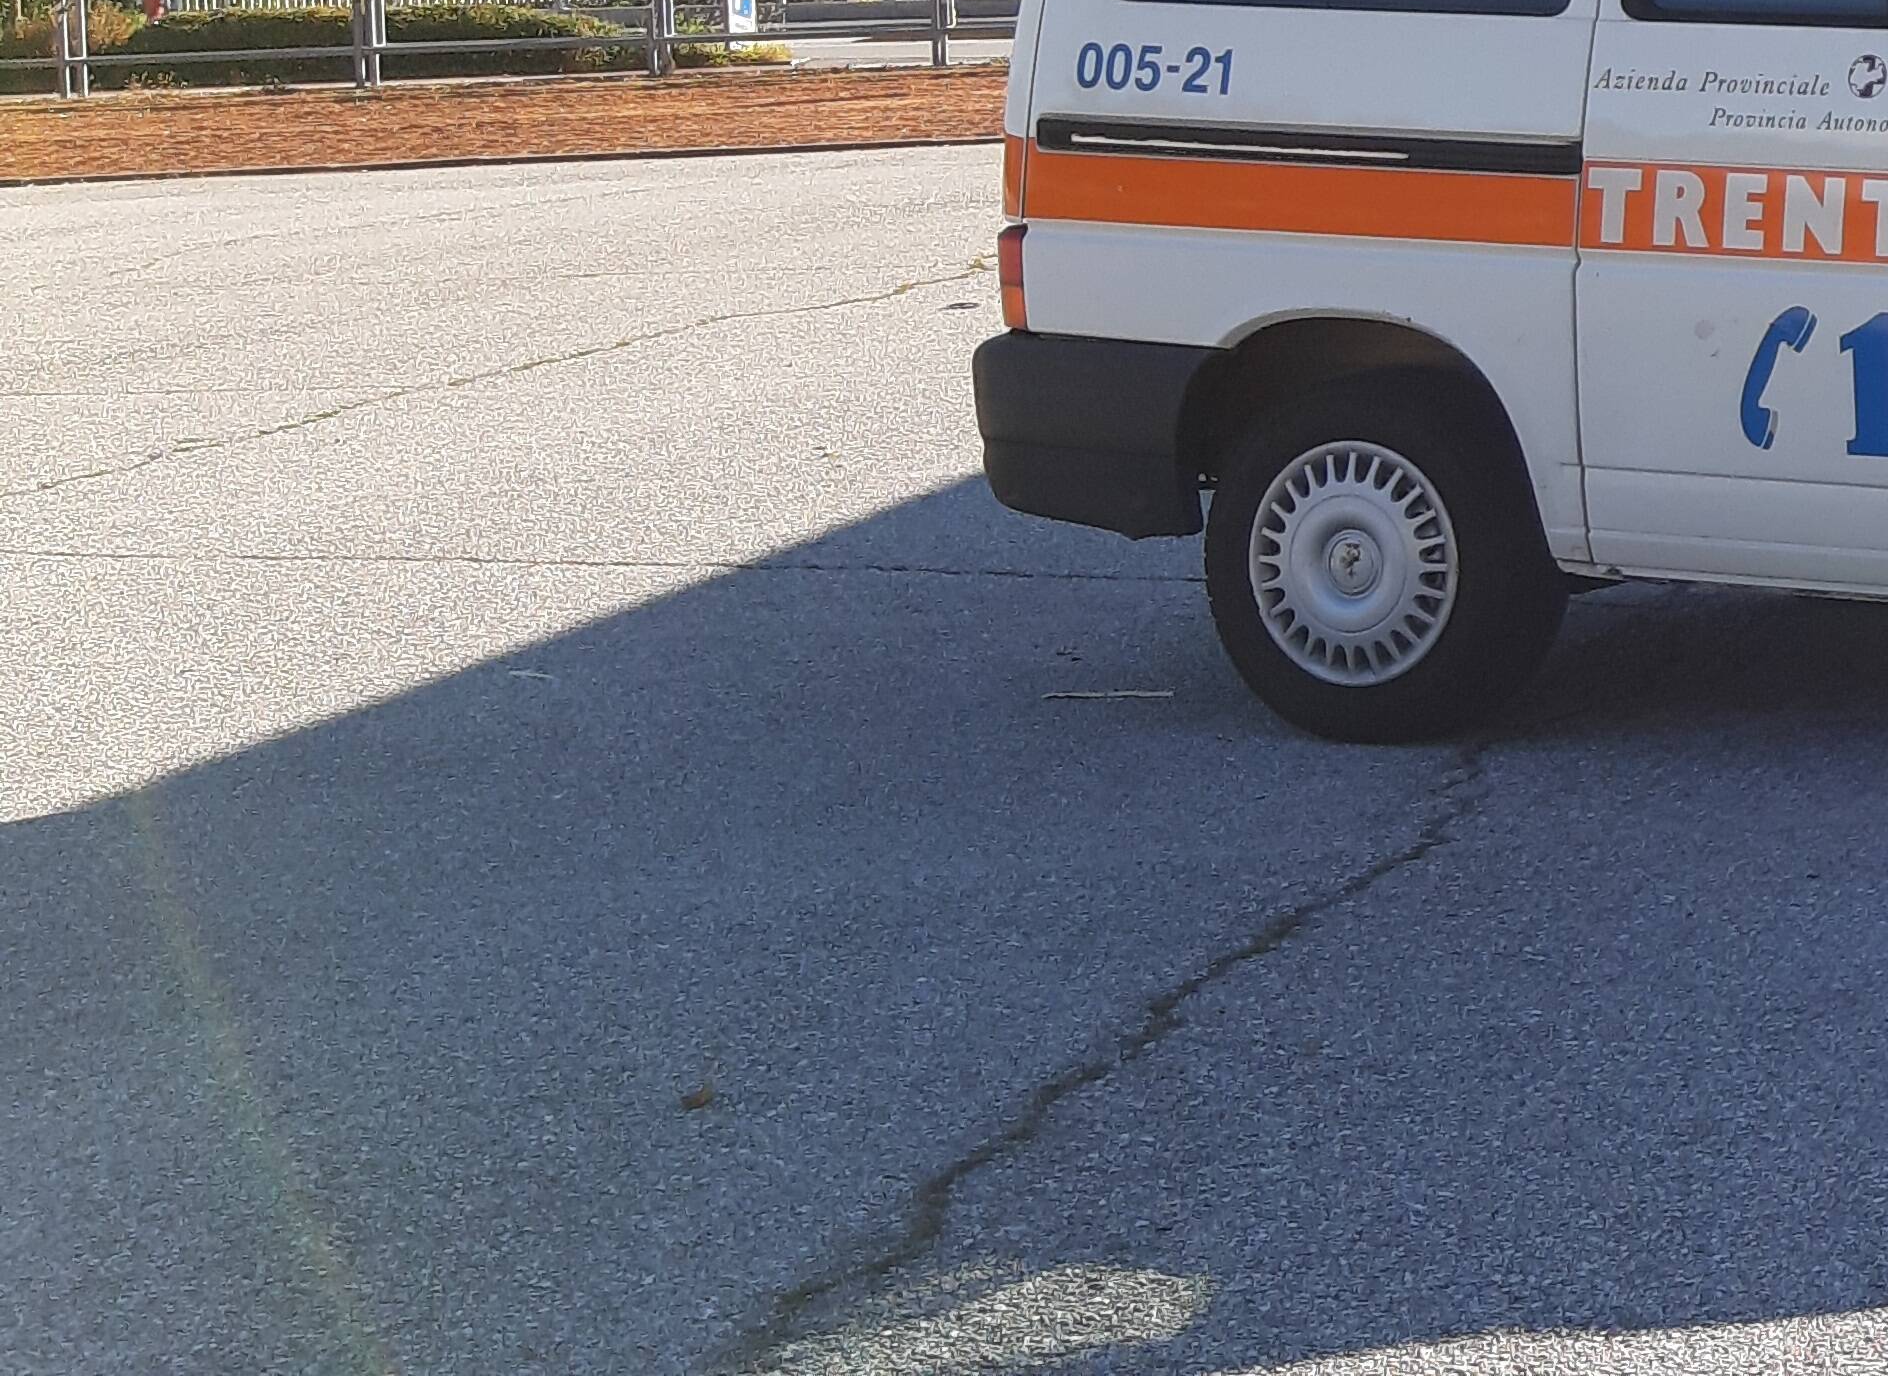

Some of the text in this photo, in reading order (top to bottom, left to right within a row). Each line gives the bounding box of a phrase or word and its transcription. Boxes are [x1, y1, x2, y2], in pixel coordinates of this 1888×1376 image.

[1076, 42, 1234, 96] 005-21
[1594, 67, 1688, 92] Azienda
[1699, 71, 1830, 97] Provinciale
[1708, 107, 1807, 131] Provincia
